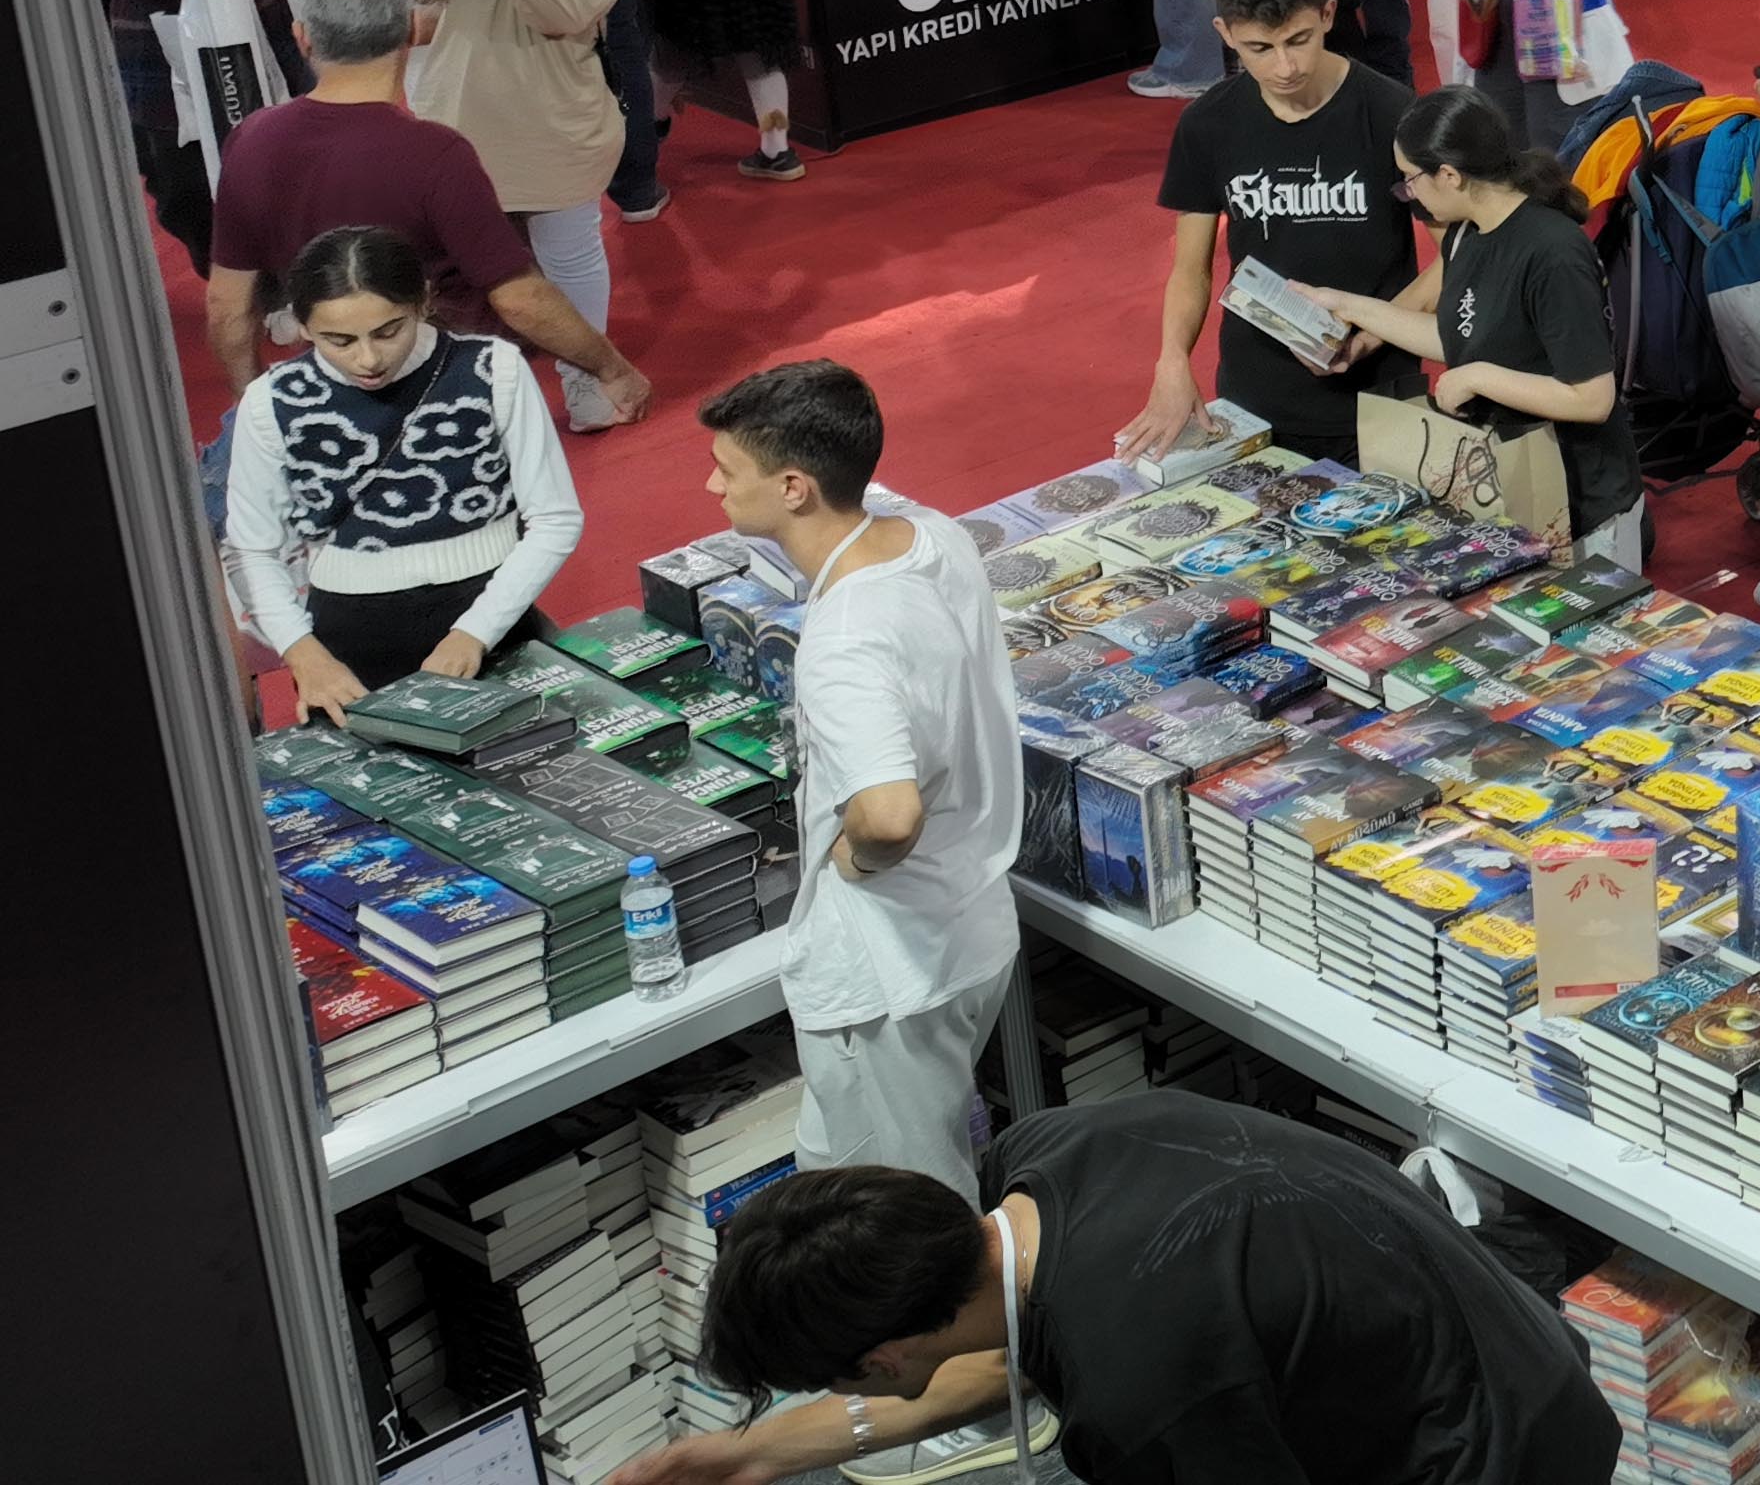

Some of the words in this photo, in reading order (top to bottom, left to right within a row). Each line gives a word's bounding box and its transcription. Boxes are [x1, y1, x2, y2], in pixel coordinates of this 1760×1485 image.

[836, 29, 896, 66] YAPI
[903, 4, 982, 50] KREDİ
[1227, 156, 1369, 241] Staunch
[1483, 916, 1533, 946] ALTINDA
